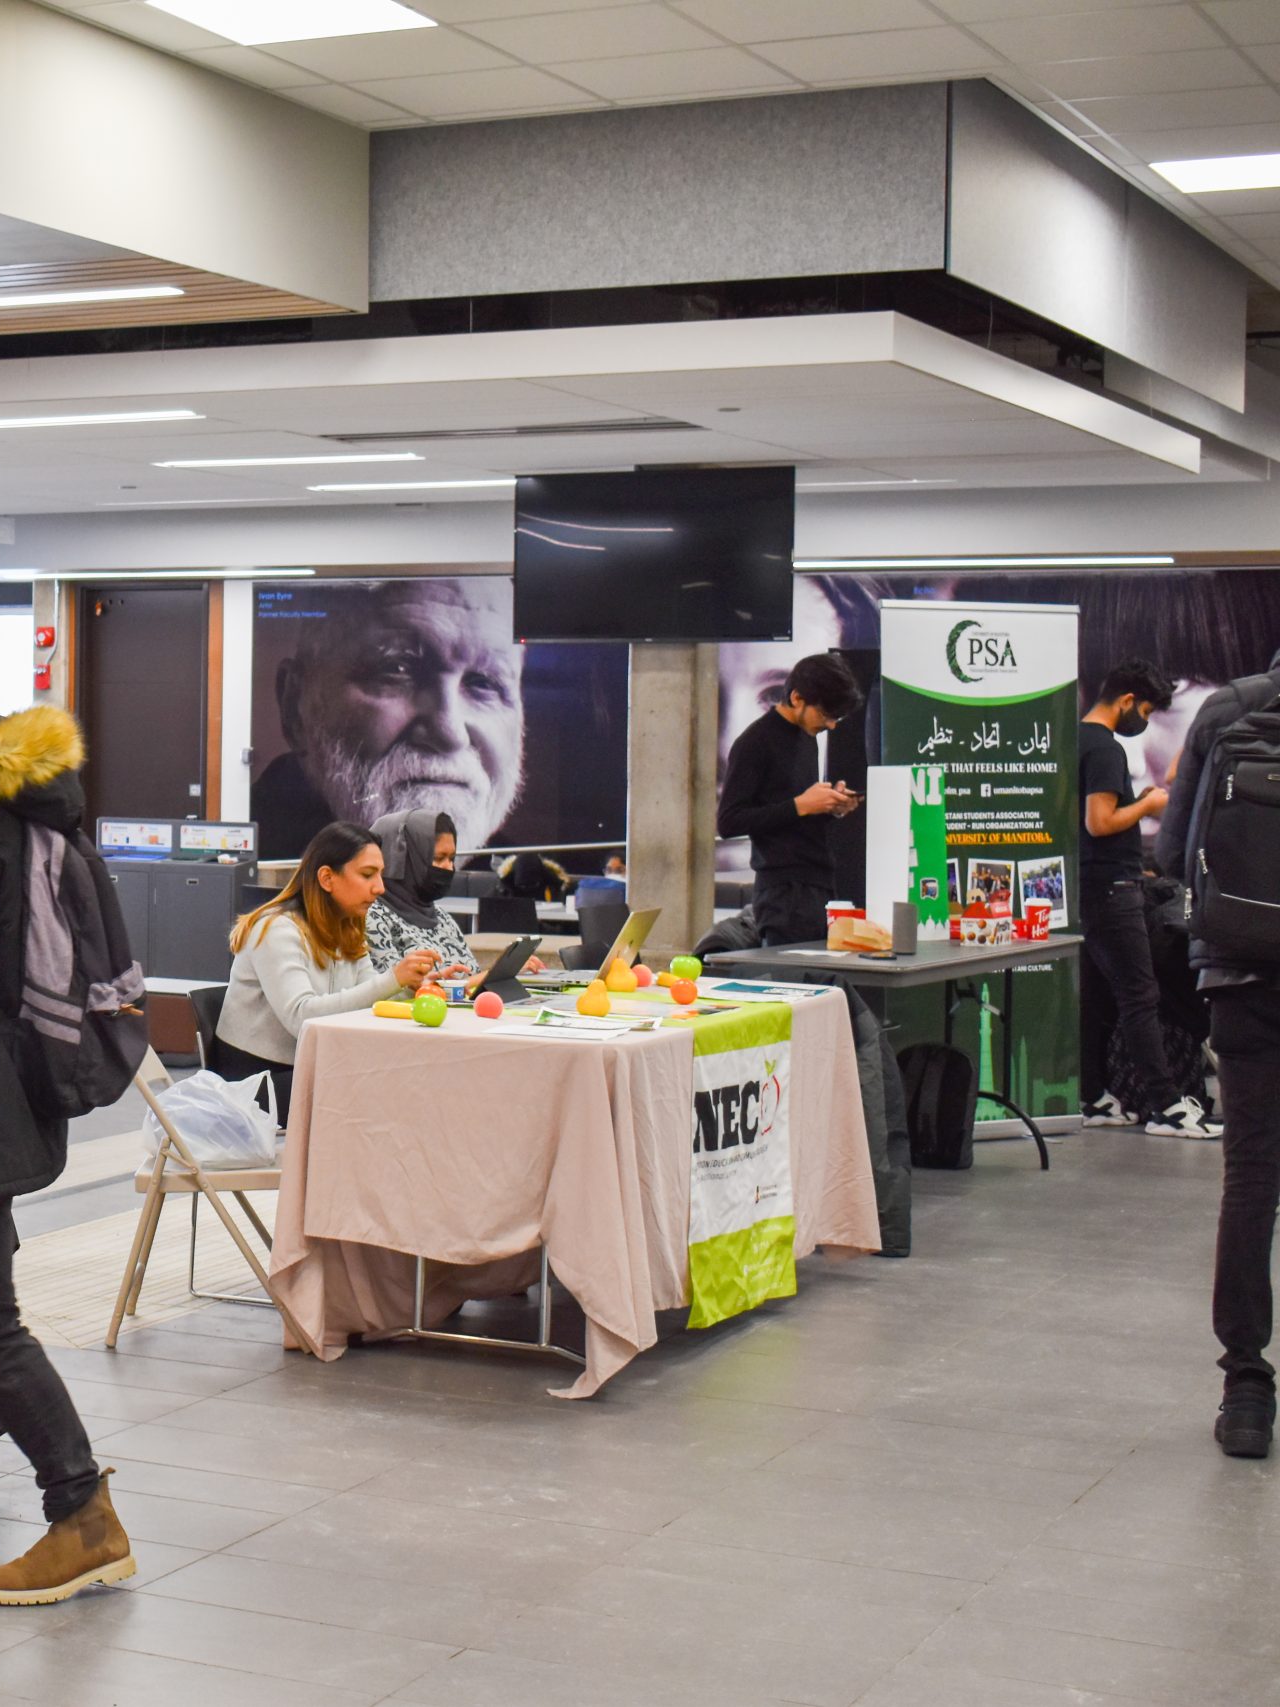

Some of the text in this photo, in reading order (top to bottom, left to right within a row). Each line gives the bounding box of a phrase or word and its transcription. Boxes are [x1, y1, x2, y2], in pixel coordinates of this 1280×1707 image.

[967, 638, 1017, 667] PSA
[950, 762, 974, 773] THAT
[975, 762, 1003, 773] FEELS
[1004, 762, 1026, 773] LIKE
[1026, 762, 1058, 773] HOME!
[964, 812, 995, 820] STUDENTS
[995, 811, 1040, 820] ASSOCIATION
[972, 822, 985, 830] RUN
[985, 821, 1034, 830] ORGANIZATION
[1034, 821, 1044, 829] AT
[989, 832, 1001, 844] OF
